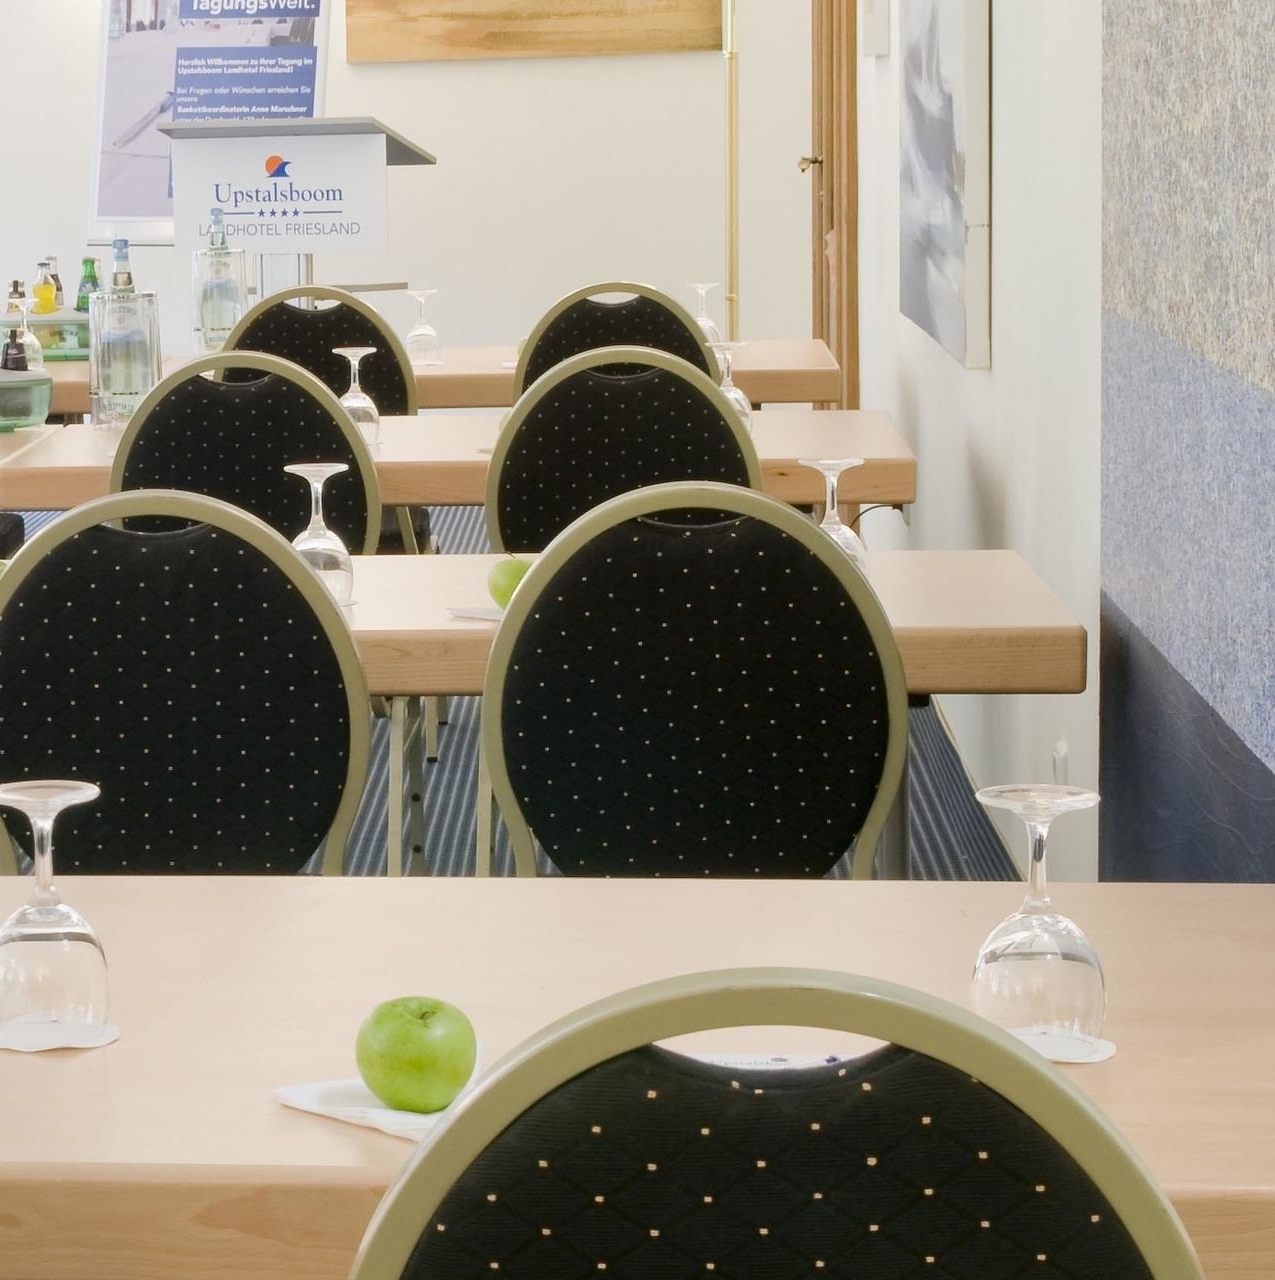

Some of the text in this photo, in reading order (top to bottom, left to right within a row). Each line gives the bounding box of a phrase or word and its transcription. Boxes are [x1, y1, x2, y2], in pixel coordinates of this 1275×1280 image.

[213, 182, 344, 208] Upstalsboom
[198, 222, 361, 237] LADHOTEL FRIESLAND
